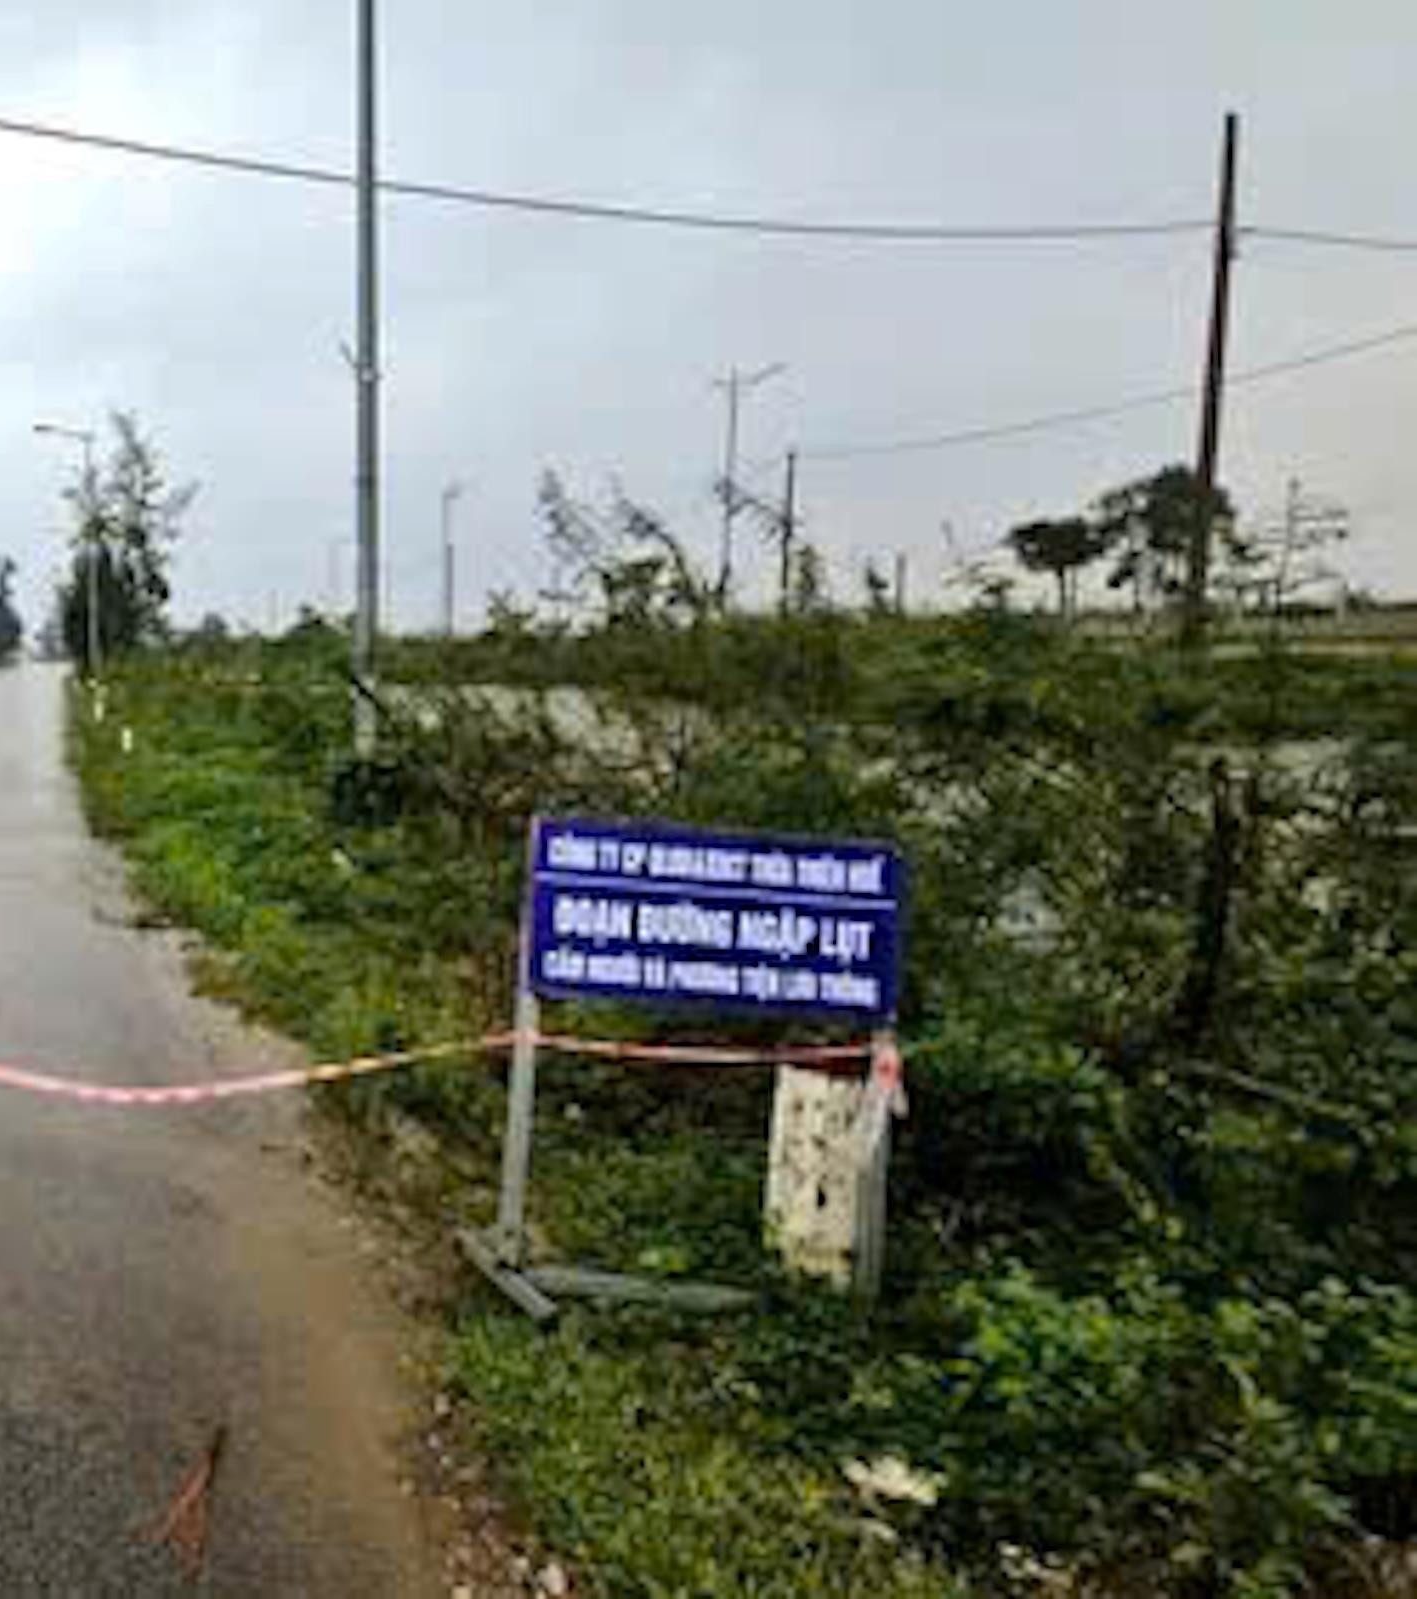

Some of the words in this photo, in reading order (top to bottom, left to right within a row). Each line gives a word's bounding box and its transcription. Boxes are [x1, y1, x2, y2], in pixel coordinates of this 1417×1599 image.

[553, 894, 632, 947] ĐOẠN
[637, 899, 733, 949] ĐƯỜNG
[737, 907, 818, 961] NGẬP
[820, 918, 875, 965] LỤT
